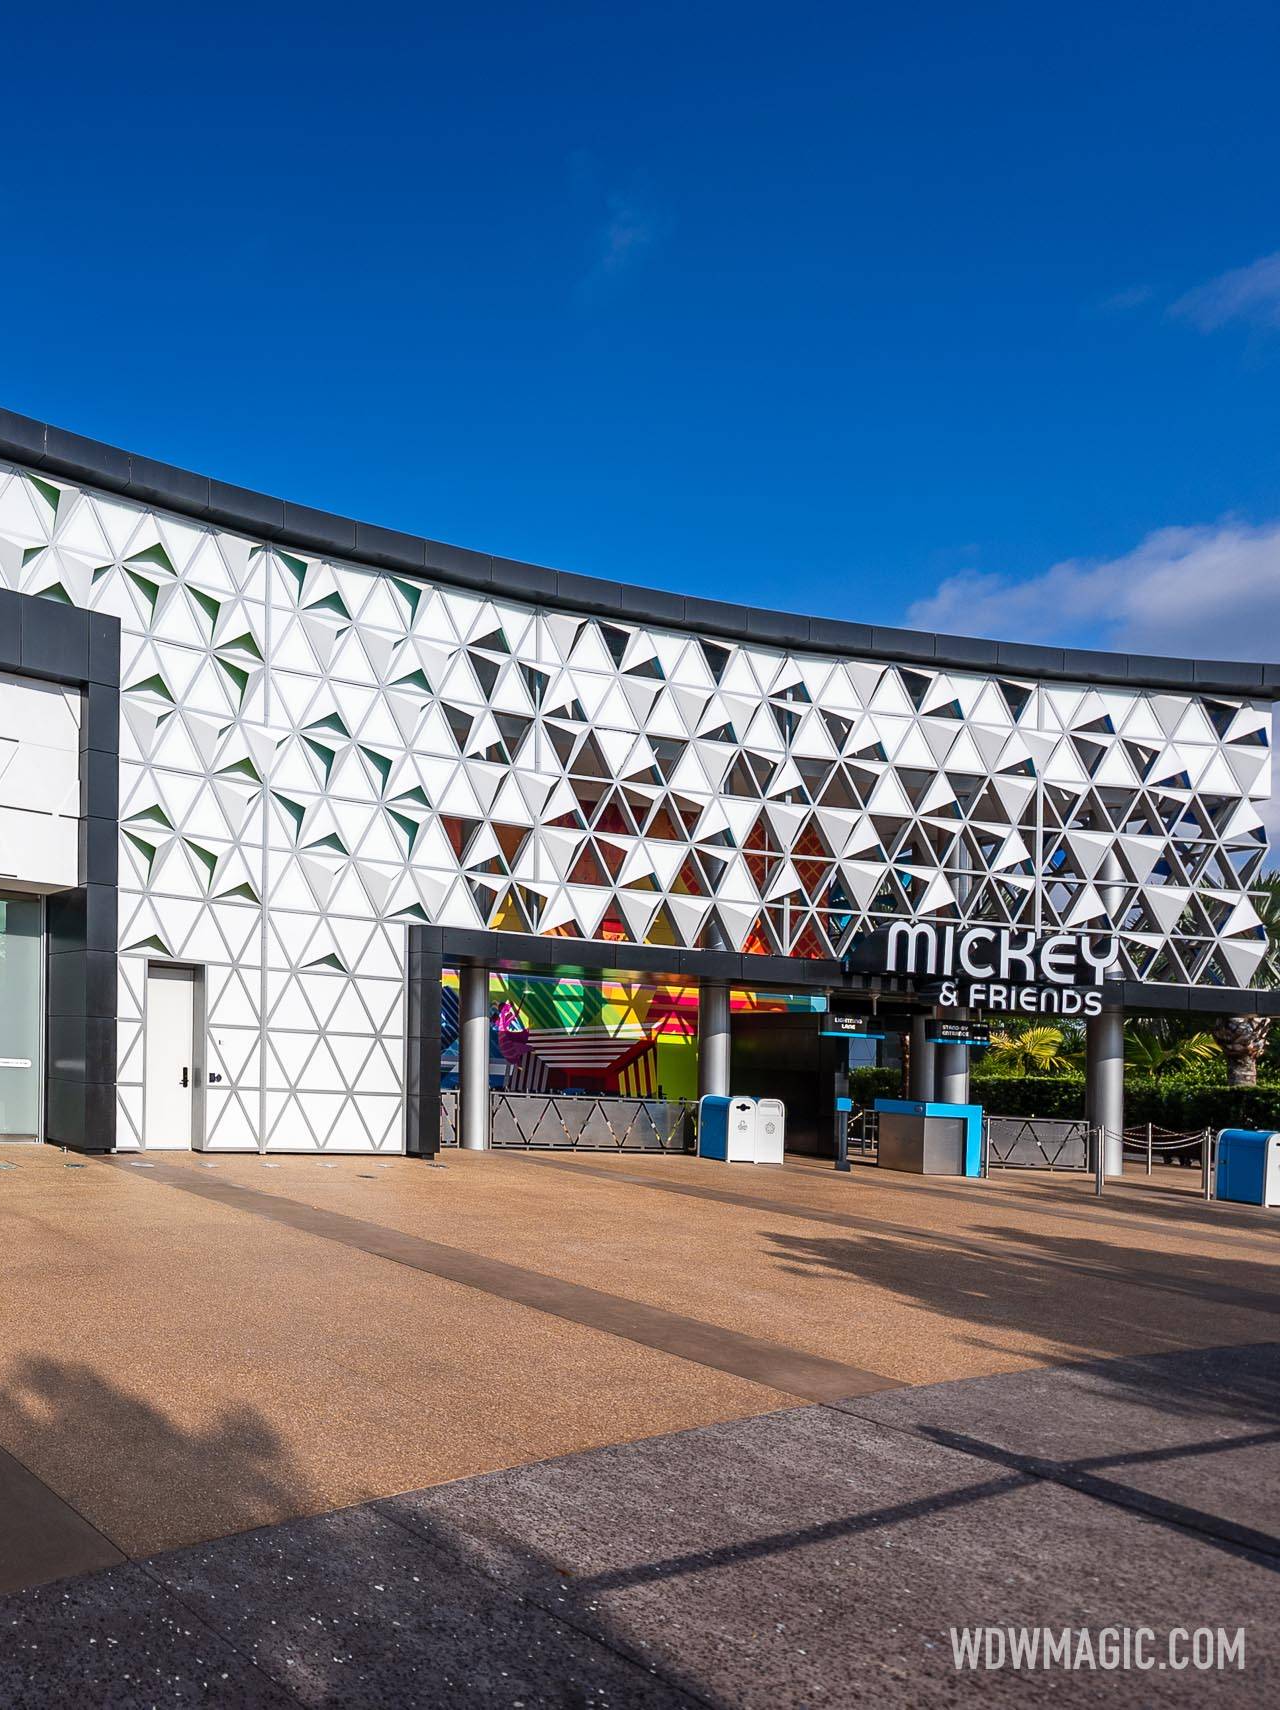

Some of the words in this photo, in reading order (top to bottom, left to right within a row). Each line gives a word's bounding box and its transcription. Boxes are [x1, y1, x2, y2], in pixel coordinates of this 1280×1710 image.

[886, 921, 1119, 985] MICKEY
[939, 981, 958, 1007] &
[969, 984, 1103, 1016] FRIENDS
